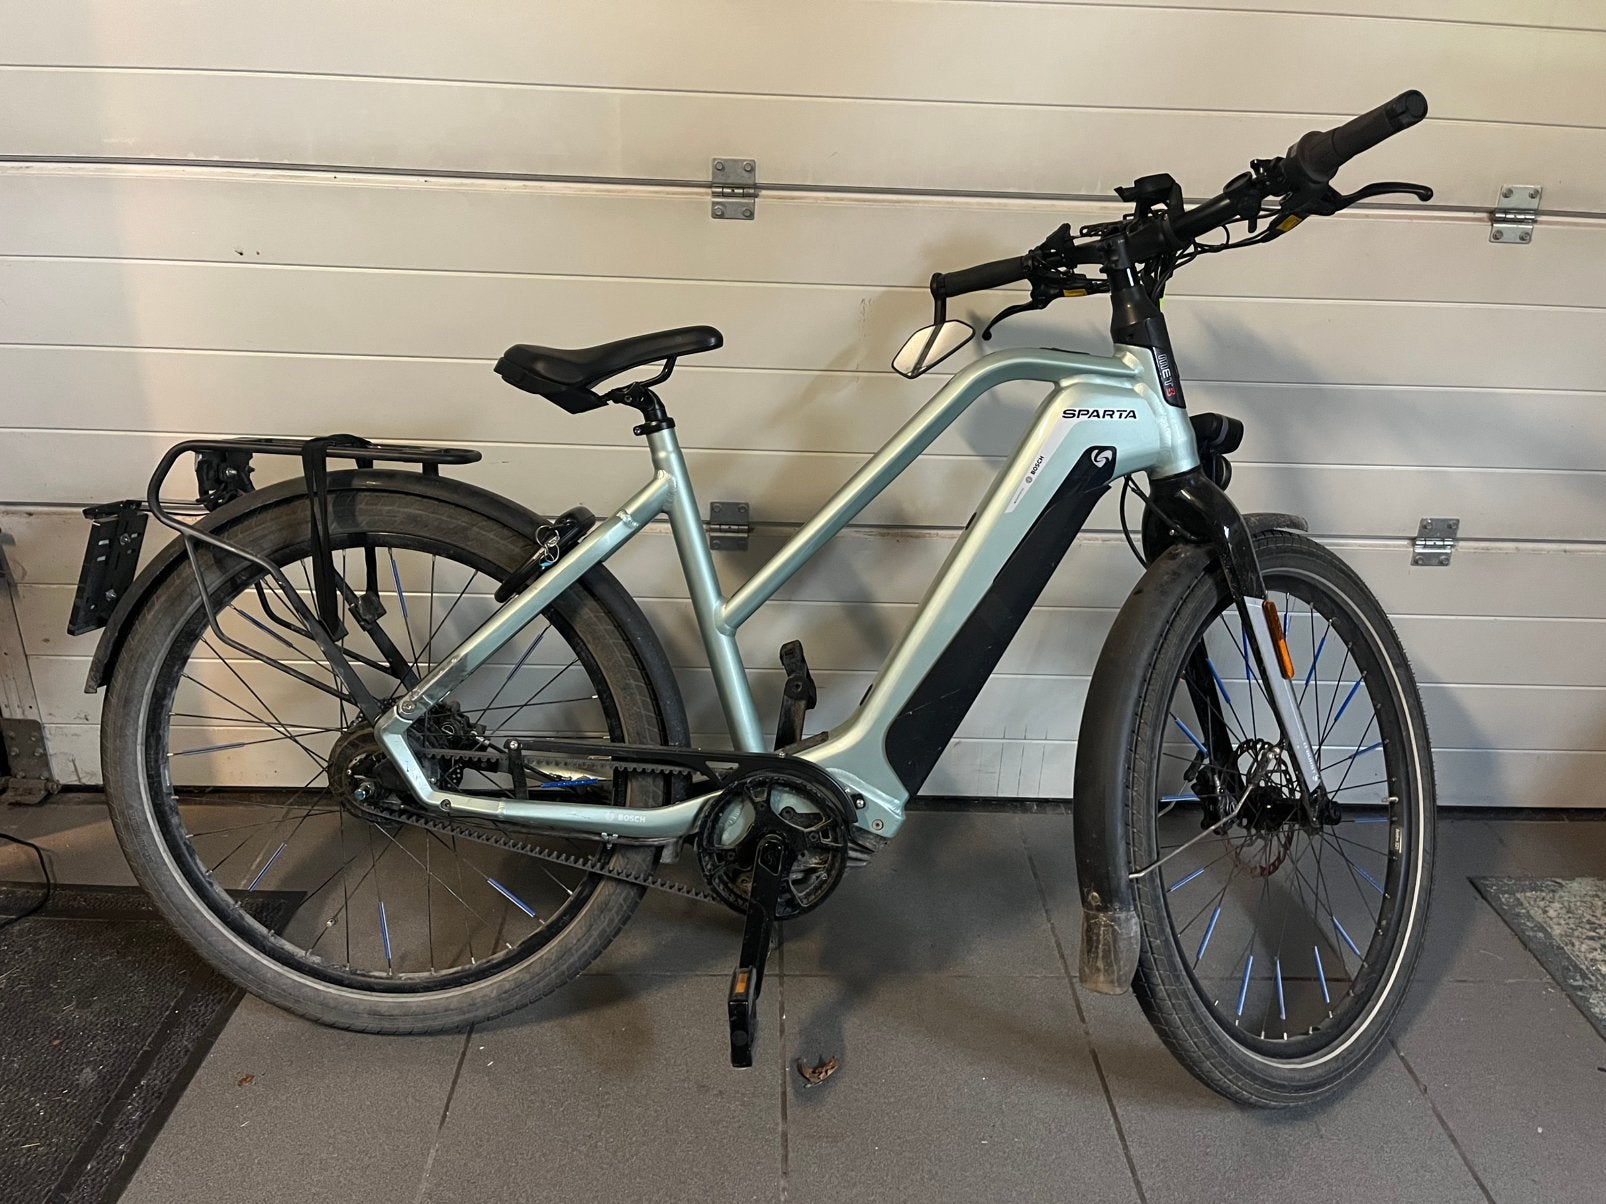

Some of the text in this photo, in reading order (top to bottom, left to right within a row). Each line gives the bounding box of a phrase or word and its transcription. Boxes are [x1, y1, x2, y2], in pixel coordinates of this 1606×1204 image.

[1061, 408, 1137, 420] SPARTA
[1030, 455, 1045, 475] BOSCH
[618, 813, 646, 823] BOSCH
